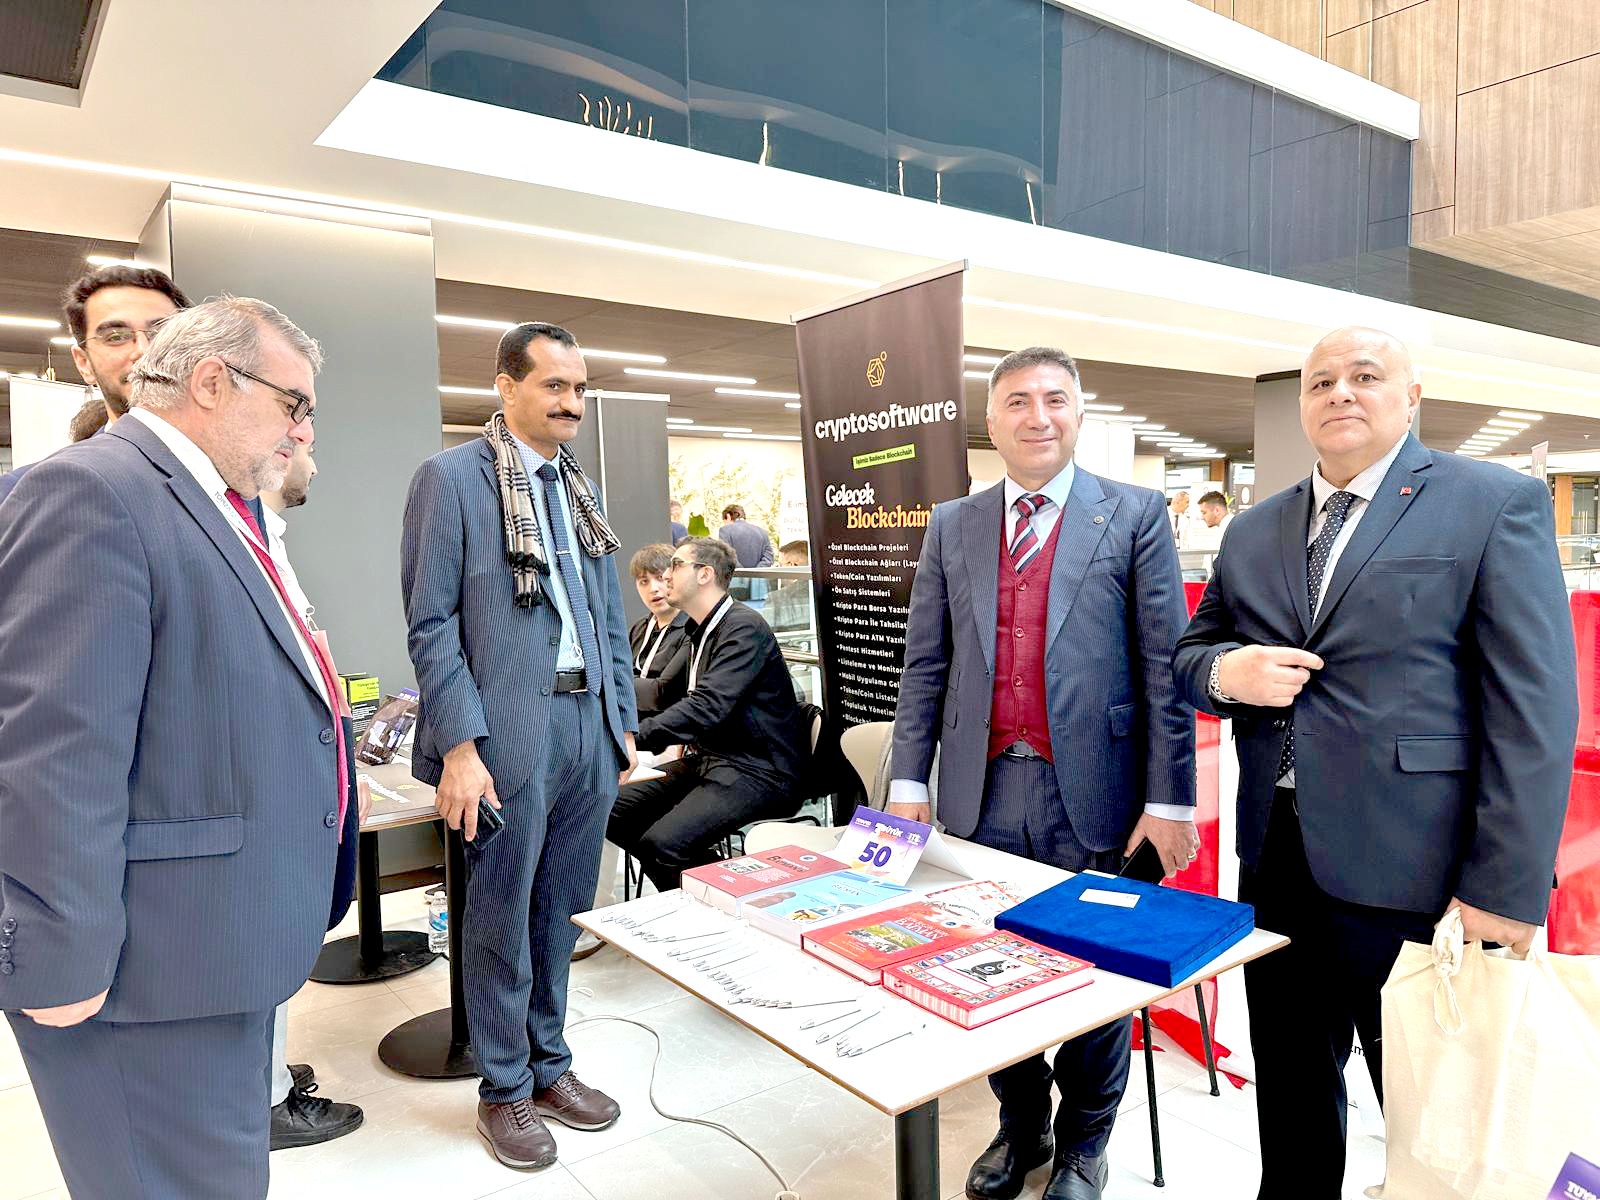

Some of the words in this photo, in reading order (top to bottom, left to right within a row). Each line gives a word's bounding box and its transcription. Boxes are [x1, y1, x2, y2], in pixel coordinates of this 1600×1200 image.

[815, 400, 957, 442] cryptosoftware
[886, 448, 913, 458] Blockchain
[826, 482, 875, 506] Gelecek
[831, 542, 842, 551] Özel
[879, 544, 909, 552] Projeleri
[832, 557, 844, 566] Özel
[844, 558, 878, 566] Blockchain
[880, 559, 901, 568] Ağları
[833, 572, 865, 581] Token/Coin
[866, 574, 902, 582] Yazılımları
[835, 585, 842, 593] Ön
[843, 587, 857, 597] Satış
[858, 588, 891, 597] Sistemleri
[836, 601, 852, 610] Kripto
[853, 603, 867, 611] Para
[868, 604, 887, 613] Borsa
[837, 616, 853, 624] Kripto
[838, 630, 854, 639] Kripto
[856, 632, 870, 640] Para
[871, 634, 884, 642] ATM
[840, 644, 860, 654] Pentest
[861, 647, 894, 658] Hizmetleri
[840, 658, 867, 669] Listeleme
[841, 671, 856, 681] Mobil
[857, 675, 887, 686] Uygulama
[842, 685, 874, 698] Token/Coin
[844, 700, 868, 712] Topluluk
[858, 841, 892, 867] 50
